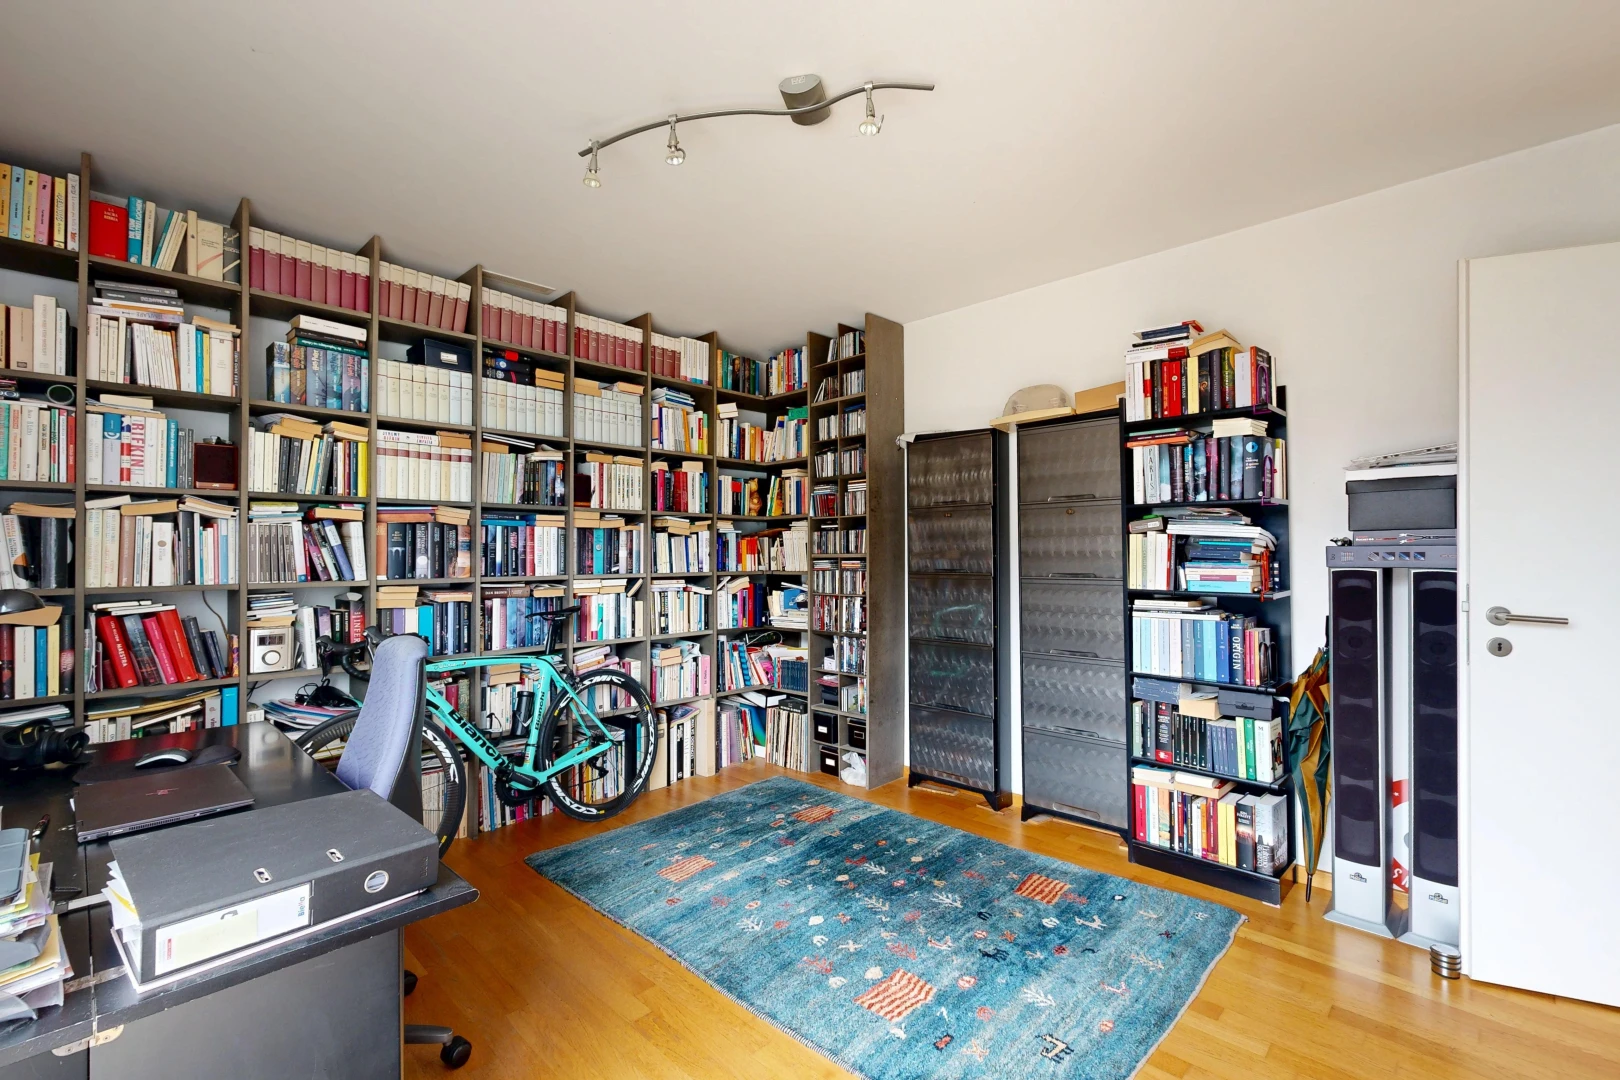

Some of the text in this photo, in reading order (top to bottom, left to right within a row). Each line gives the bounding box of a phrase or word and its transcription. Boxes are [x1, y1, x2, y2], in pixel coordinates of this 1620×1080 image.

[131, 423, 145, 467] RIFKIN
[1147, 448, 1155, 489] PARIS
[116, 643, 128, 668] MAESTRA
[1232, 636, 1241, 670] ORIGIN
[535, 691, 545, 731] Bianchi
[297, 896, 306, 917] Biella
